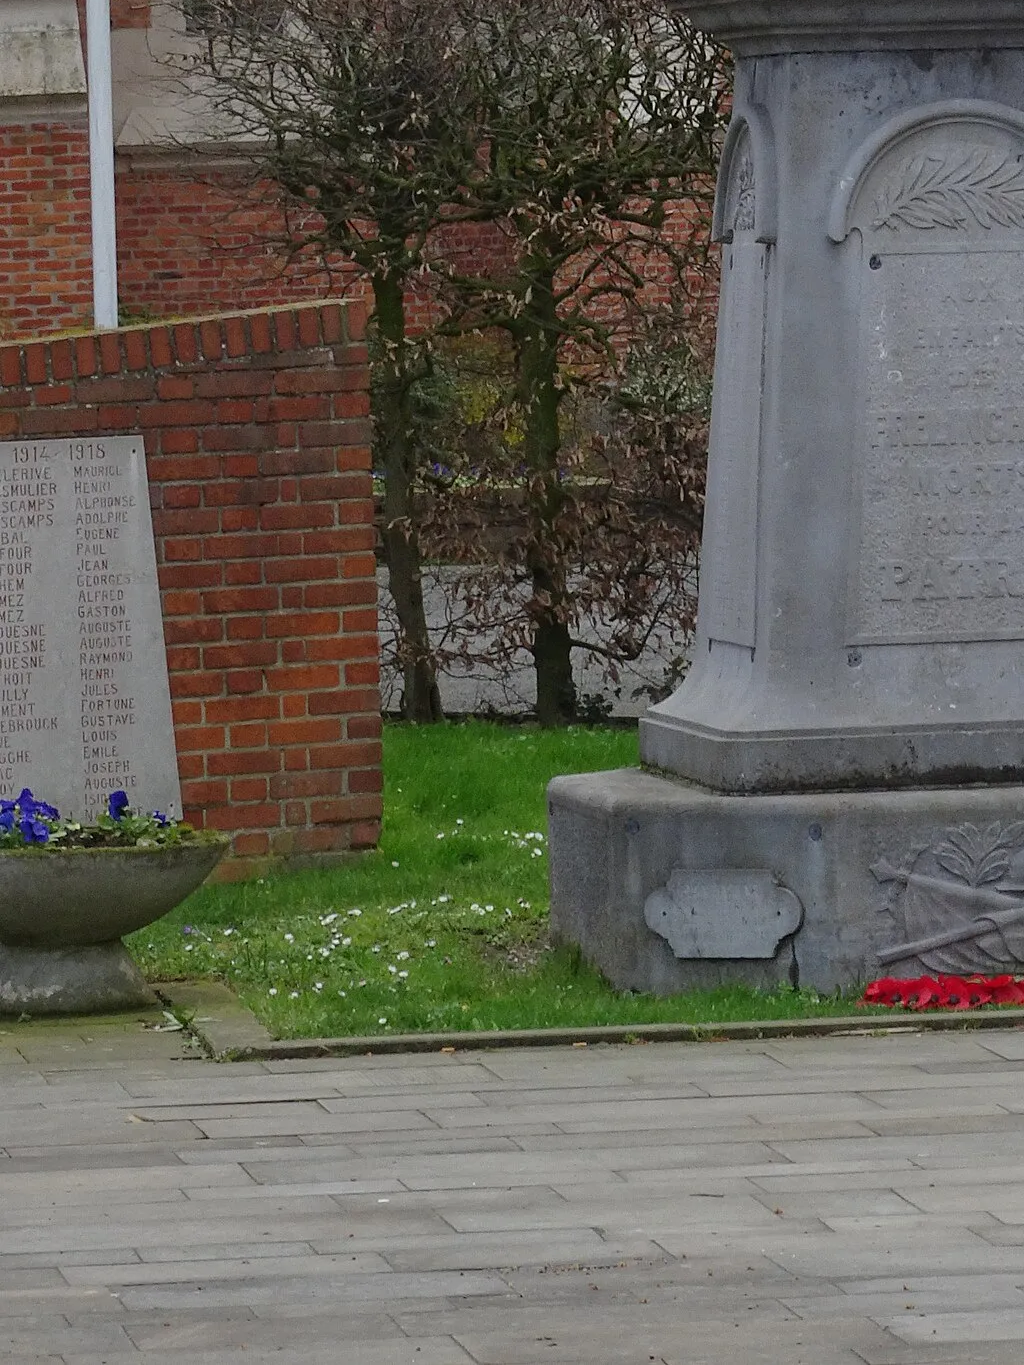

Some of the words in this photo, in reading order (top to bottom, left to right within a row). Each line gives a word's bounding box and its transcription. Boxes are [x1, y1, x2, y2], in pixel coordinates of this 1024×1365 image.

[13, 445, 50, 463] 1914
[69, 442, 106, 461] 1918
[0, 467, 52, 482] LERIVE
[0, 482, 58, 498] SMULIER
[74, 481, 112, 494] HENRI
[76, 512, 128, 524] ADOLPHE
[76, 543, 106, 556] PAUL
[77, 558, 108, 572] JEAN
[77, 574, 131, 587] GEORGES
[78, 590, 124, 603] ALFRED
[78, 606, 126, 618] GASTON
[80, 620, 132, 634] AUGUSTE
[80, 636, 132, 650] AUGUSTE
[80, 651, 133, 666] RAYMOND
[80, 668, 114, 680] HENRI
[81, 684, 118, 696] JULES
[80, 714, 136, 728] GUSTAVE
[82, 730, 118, 743] LOUIS
[84, 746, 119, 760] EMILE
[84, 760, 130, 774] JOSEPH
[84, 775, 136, 790] AUGUSTE
